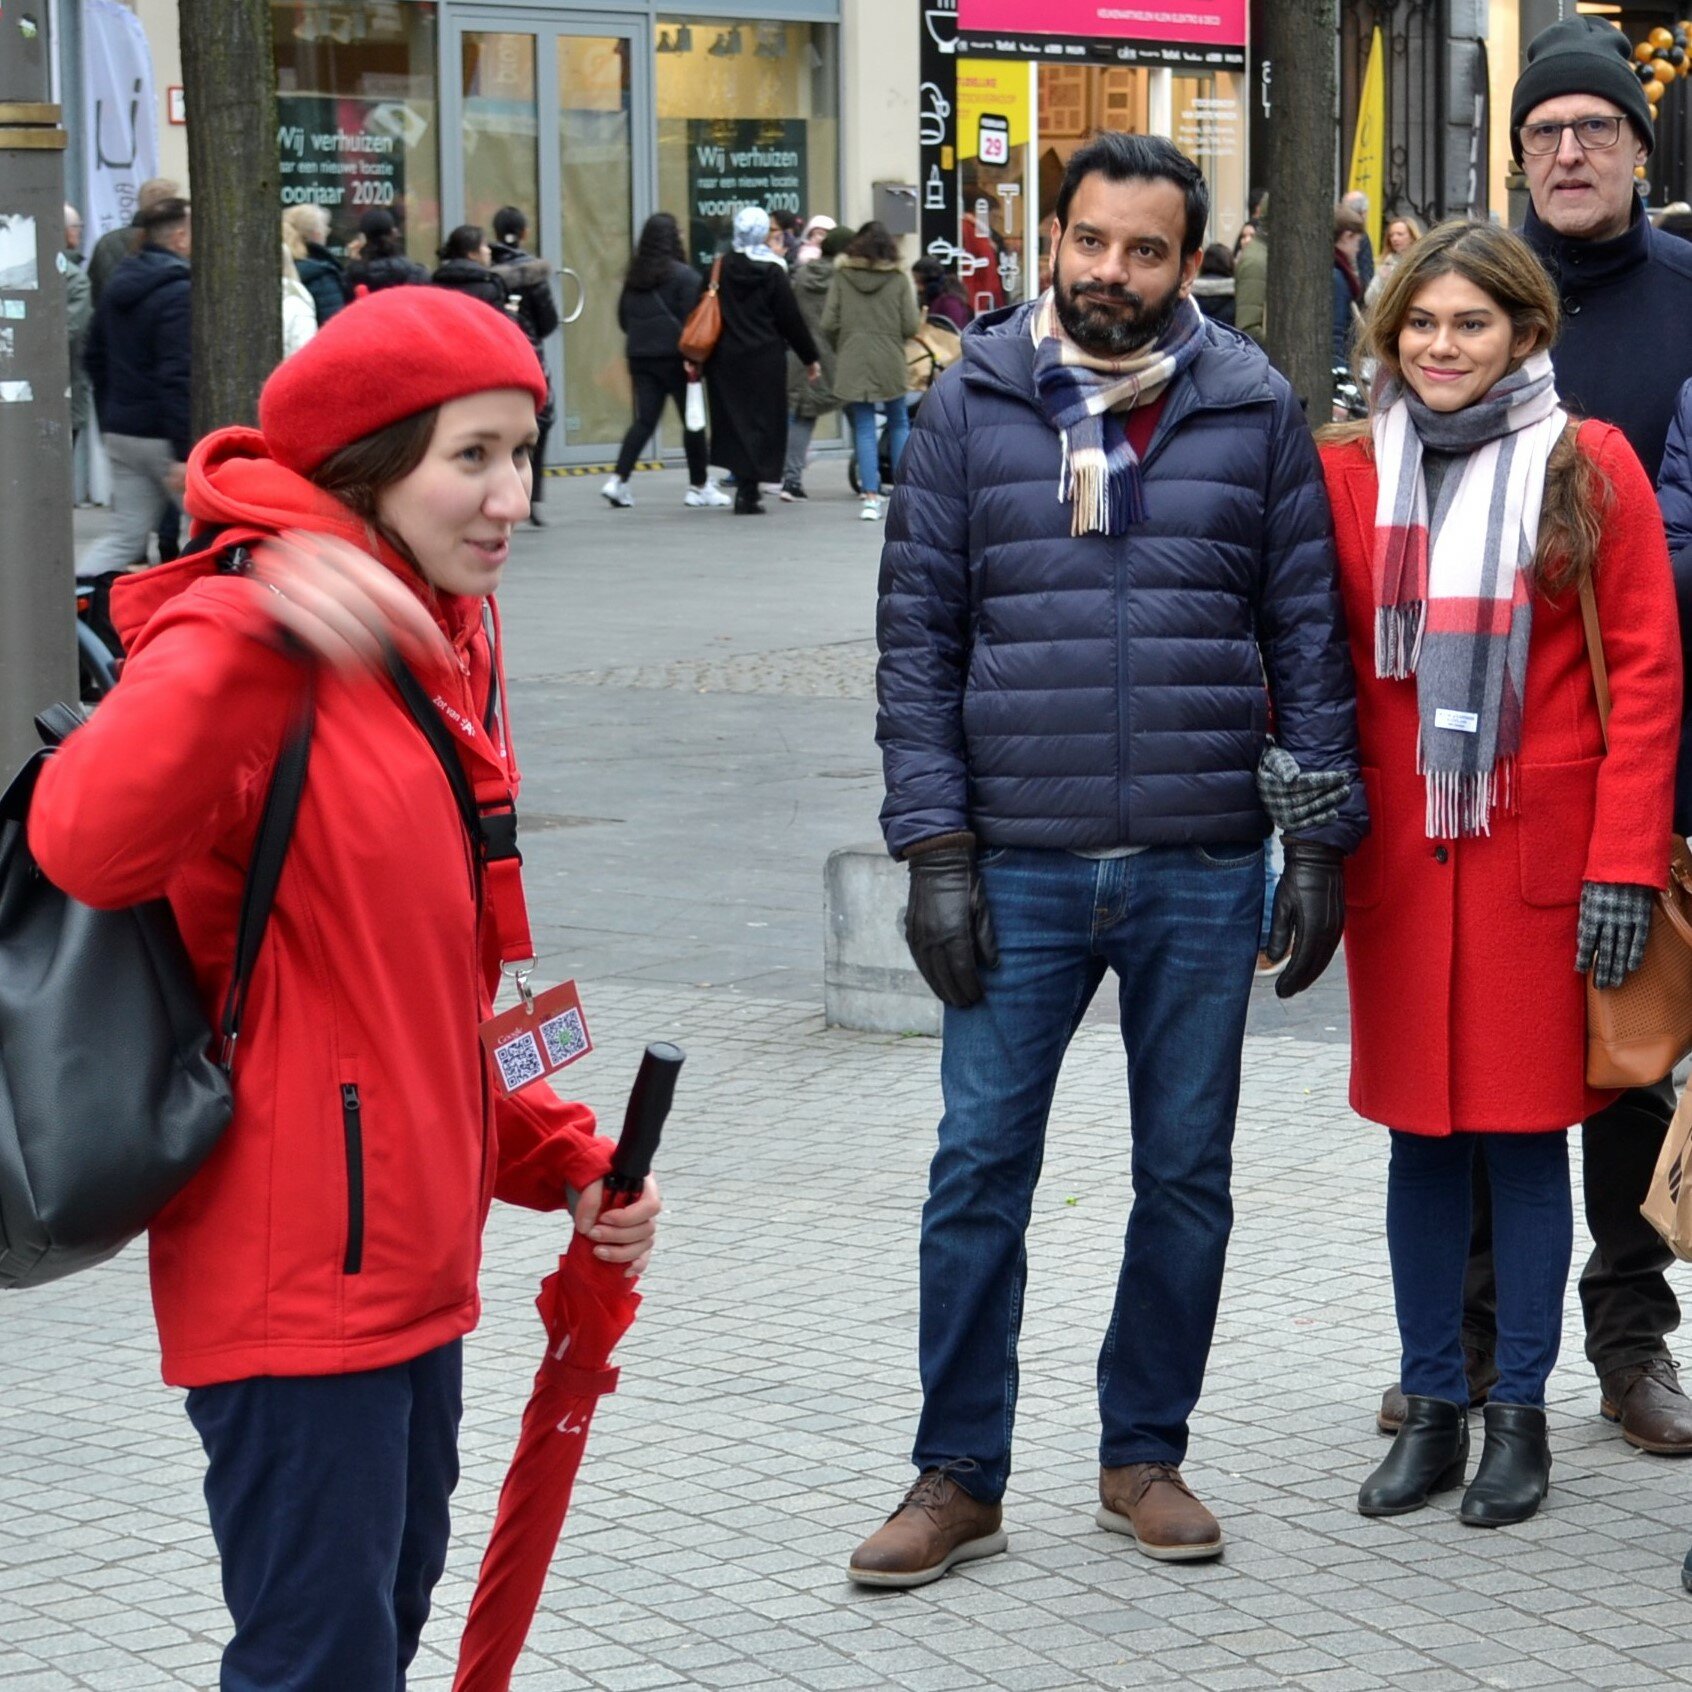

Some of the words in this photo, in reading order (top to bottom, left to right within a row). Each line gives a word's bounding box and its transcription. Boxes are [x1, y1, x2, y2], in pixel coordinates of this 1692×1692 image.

[310, 128, 393, 153] verhuizen
[984, 136, 1002, 156] 29
[696, 145, 725, 174] Wij
[729, 146, 798, 167] verhuizen
[280, 181, 345, 204] oorjaar
[351, 180, 393, 205] 2020
[432, 695, 447, 710] Zot
[446, 707, 460, 722] van
